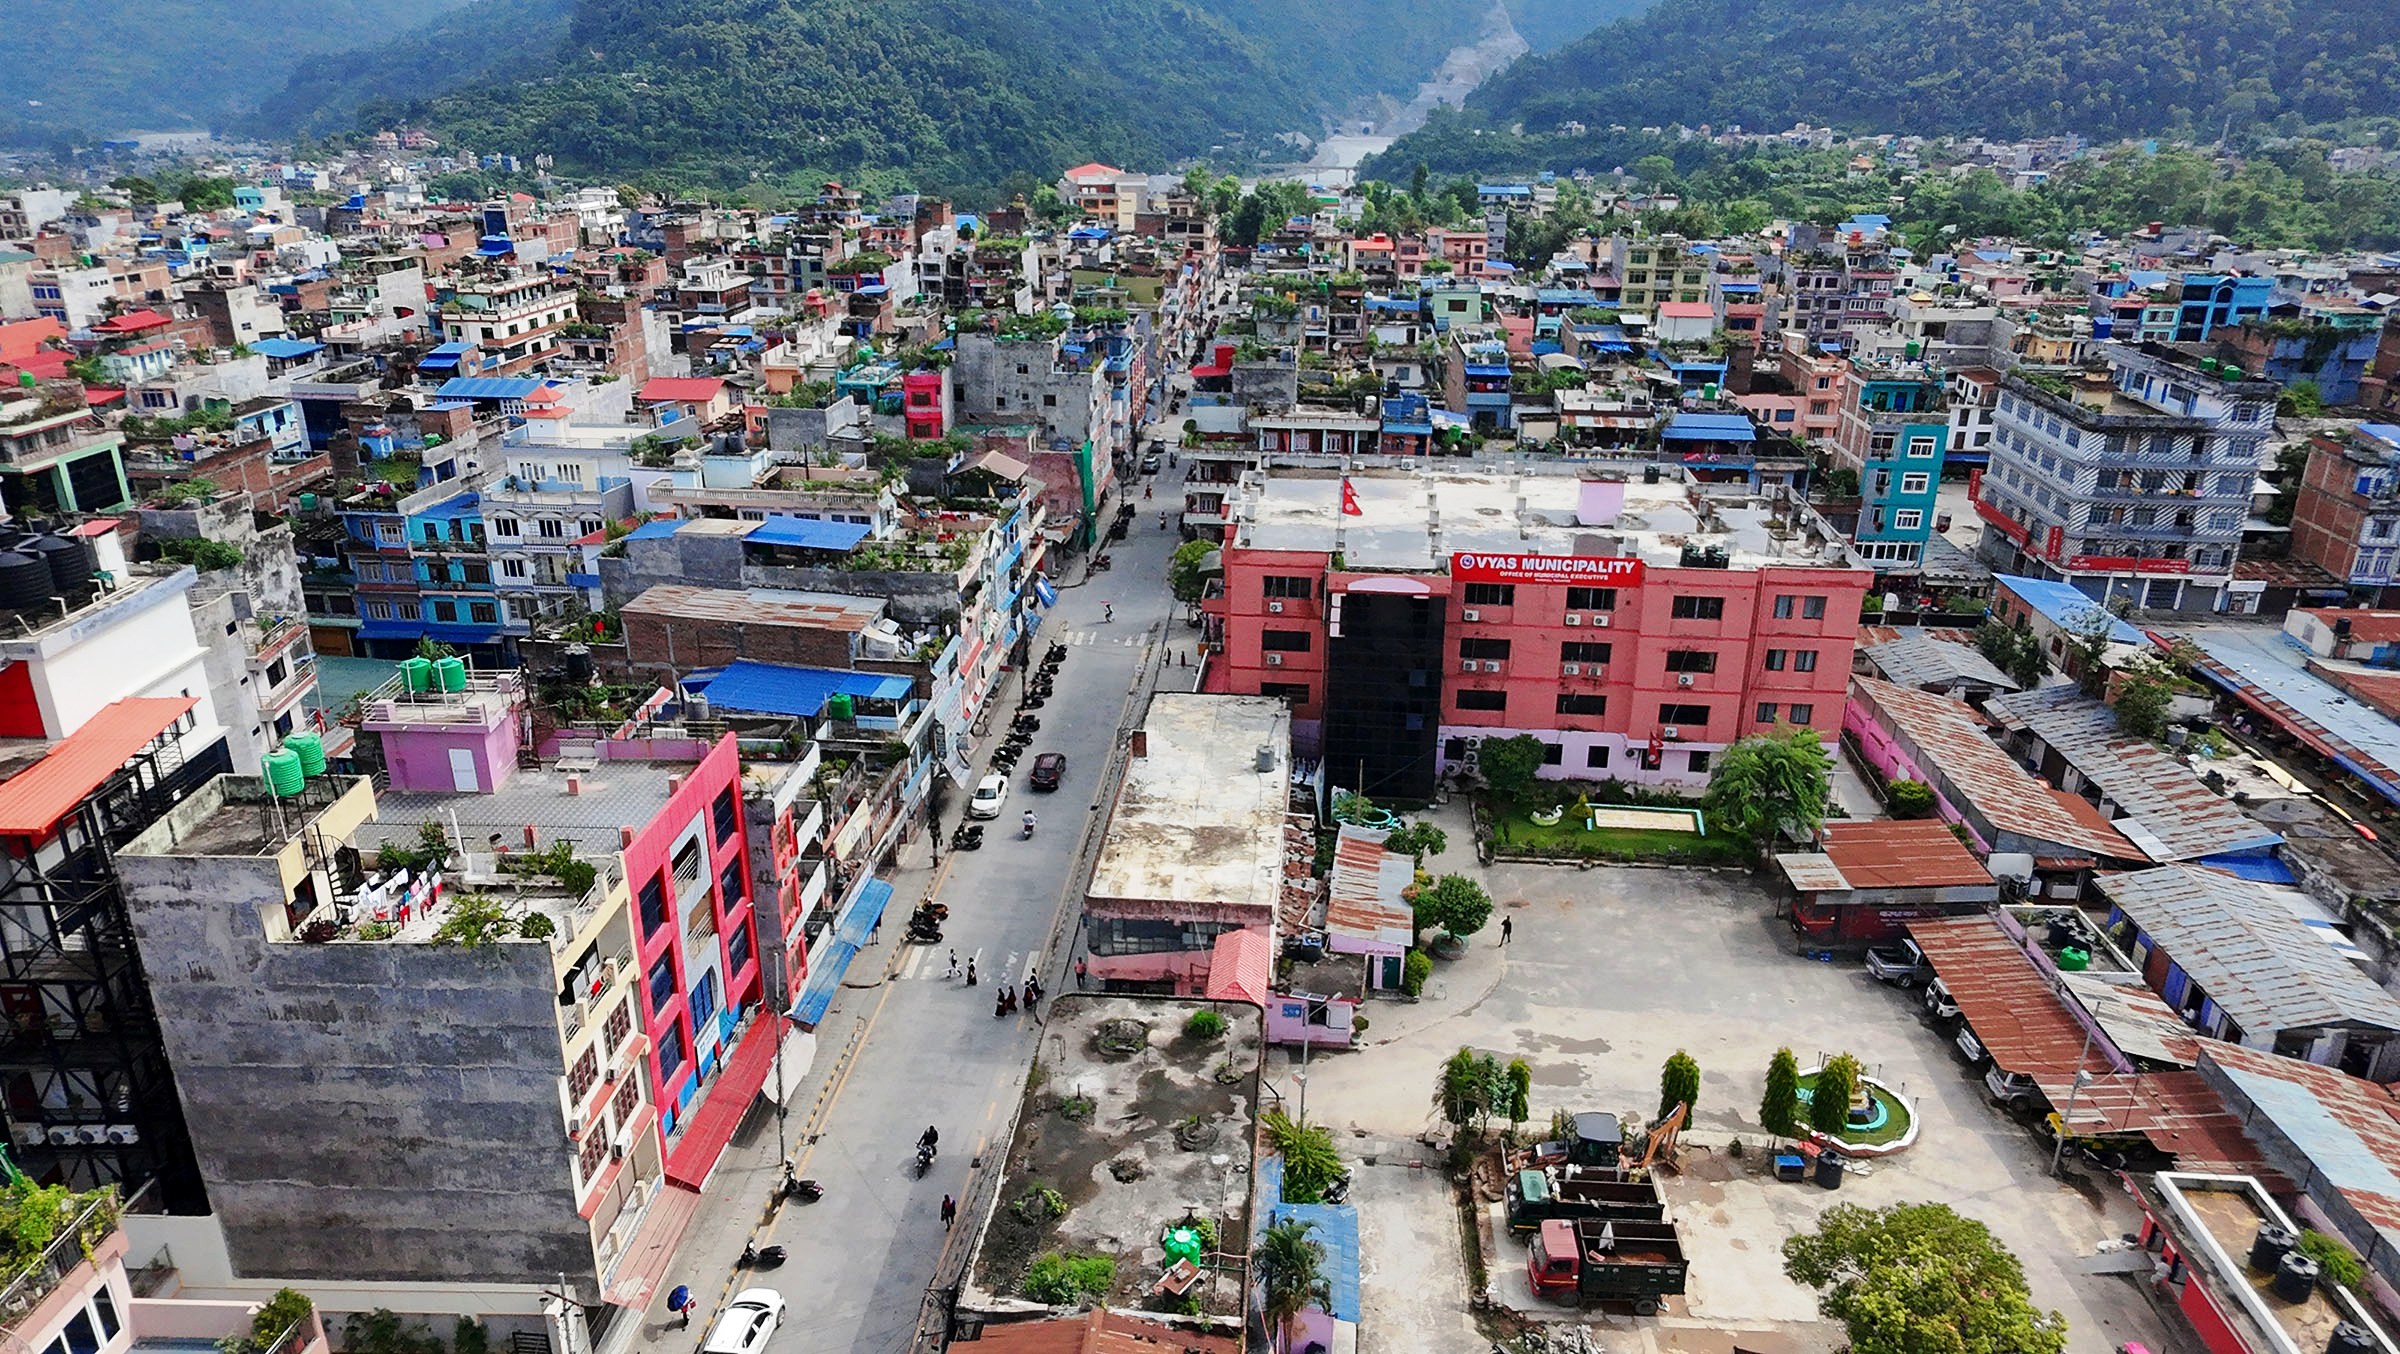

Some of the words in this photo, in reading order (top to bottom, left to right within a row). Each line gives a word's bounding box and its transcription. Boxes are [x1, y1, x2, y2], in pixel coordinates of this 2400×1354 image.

[1476, 557, 1517, 570] VYAS
[1522, 558, 1635, 574] MUNICIPALITY
[1570, 573, 1608, 581] EXECUTIVE
